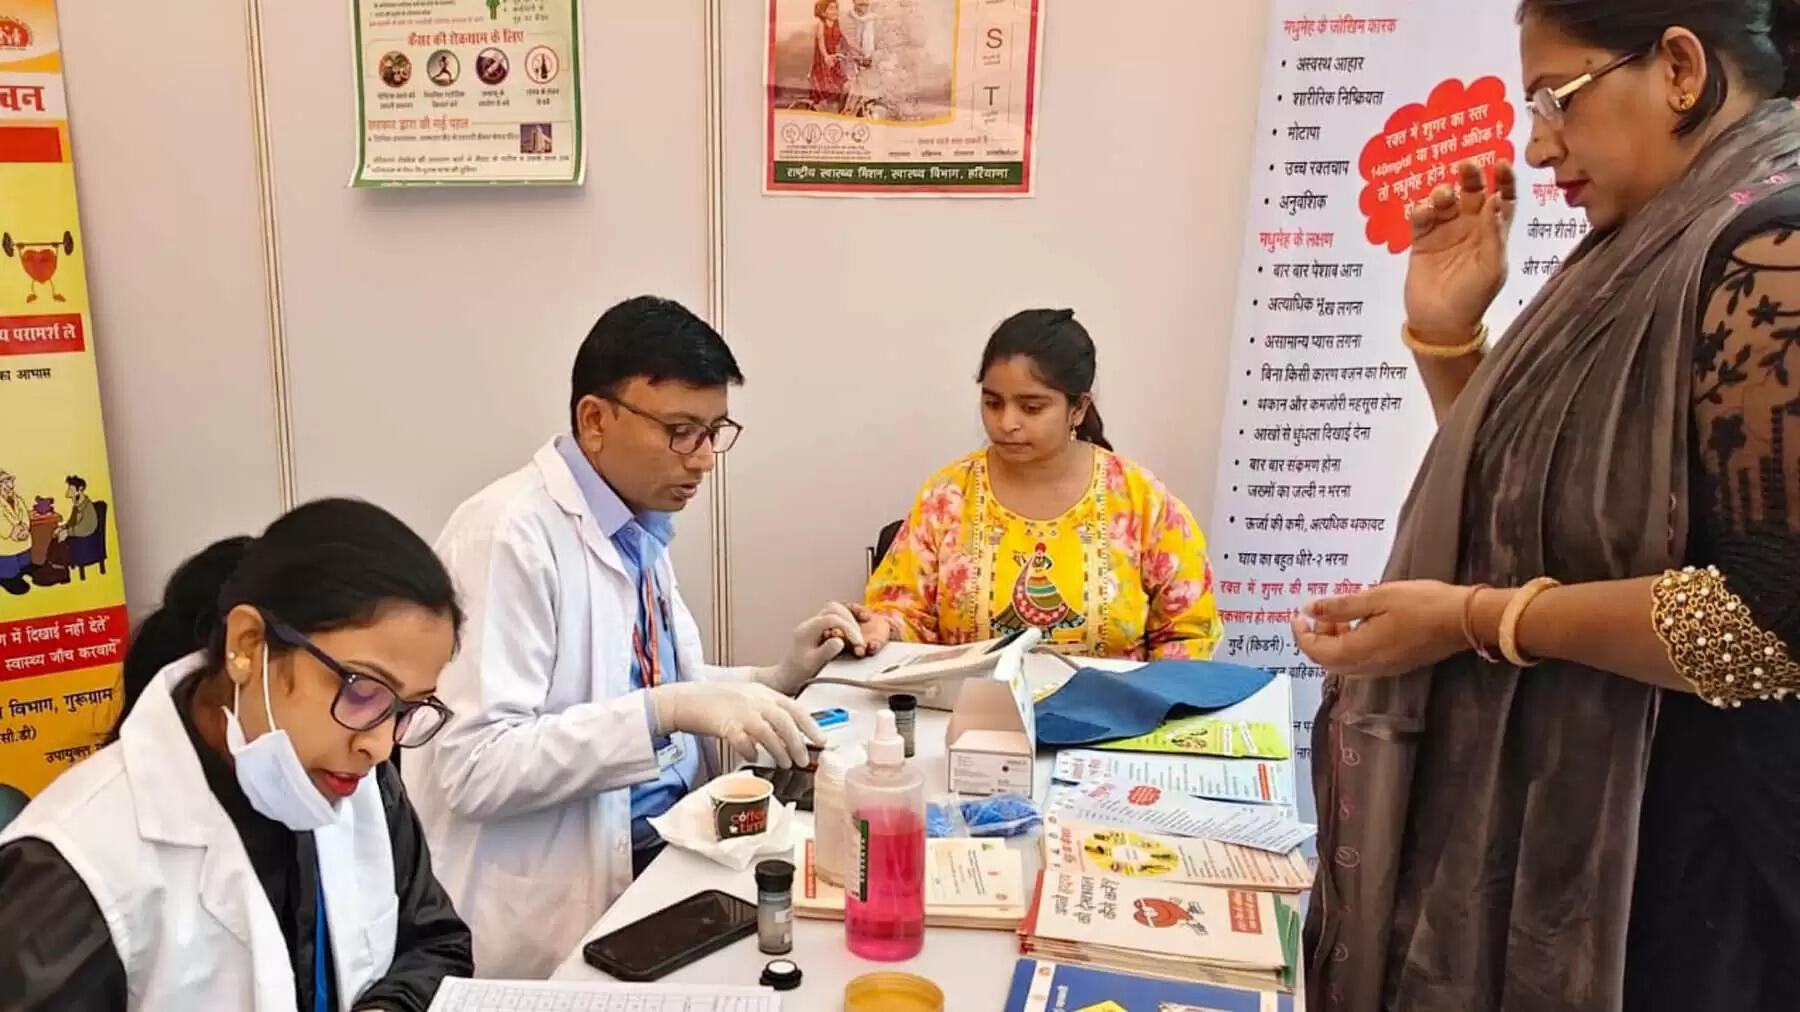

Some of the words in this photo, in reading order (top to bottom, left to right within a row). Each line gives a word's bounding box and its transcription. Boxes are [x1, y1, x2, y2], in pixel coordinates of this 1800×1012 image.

[1284, 15, 1315, 41] मधुमेह
[1318, 15, 1328, 33] के
[1330, 14, 1365, 33] जोखिम
[1368, 18, 1398, 32] कारक
[986, 28, 1003, 48] S
[1296, 57, 1332, 72] अस्वस्थ
[1334, 57, 1364, 72] आहार
[984, 86, 1000, 106] T
[1293, 86, 1335, 106] शारीरिक
[1288, 121, 1320, 140] मोटापा
[1386, 130, 1406, 148] रक्त
[1411, 122, 1419, 140] में
[1422, 117, 1446, 140] शुगर
[1451, 112, 1464, 128] का
[1469, 104, 1488, 120] स्तर
[1416, 148, 1428, 162] या
[1432, 134, 1456, 160] इससे
[1462, 128, 1492, 148] अधिक
[1285, 161, 1306, 176] उच्च
[1310, 160, 1350, 176] रक्तचाप
[1378, 183, 1388, 202] तो
[1394, 172, 1423, 200] मधुमेह
[1427, 162, 1446, 186] होने
[1472, 151, 1496, 168] तरा
[1528, 217, 1552, 239] जीवन
[1555, 217, 1576, 239] शैली
[1260, 228, 1290, 253] मधुमेह
[1293, 228, 1304, 248] के
[1306, 233, 1334, 248] लक्षण
[1273, 264, 1289, 278] बार
[1292, 264, 1309, 278] बार
[1312, 260, 1338, 278] पेशाब
[1340, 264, 1363, 278] आना
[1522, 256, 1540, 275] और
[1268, 293, 1313, 312] अत्याधिक
[1337, 301, 1363, 316] लगना
[1264, 335, 1309, 349] असामान्य
[1312, 335, 1334, 349] प्यास
[1336, 334, 1362, 349] लगना
[16, 368, 51, 380] आभास
[1262, 363, 1282, 382] बिना
[1285, 363, 1310, 382] किसी
[1312, 368, 1338, 382] कारण
[1366, 367, 1377, 379] का
[1380, 362, 1408, 379] गिरना
[1258, 398, 1286, 411] थकान
[1290, 395, 1308, 411] और
[1310, 393, 1346, 411] कमजोरी
[1349, 398, 1378, 414] महसूस
[1381, 393, 1402, 411] होना
[1282, 423, 1291, 440] से
[1322, 422, 1350, 442] दिखाई
[1354, 422, 1371, 440] देना
[1250, 458, 1266, 472] बार
[1269, 458, 1284, 472] बार
[1322, 454, 1342, 472] होना
[1278, 485, 1290, 498] का
[1292, 481, 1316, 498] जल्दी
[1318, 485, 1326, 498] न
[1328, 485, 1352, 498] भरना
[1245, 513, 1269, 531] ऊर्जा
[1271, 513, 1283, 531] की
[1350, 518, 1384, 532] थकावट
[1238, 552, 1256, 566] घाव
[1259, 552, 1272, 566] का
[1274, 553, 1293, 572] बहुत
[1325, 552, 1348, 566] भरना
[1220, 581, 1242, 595] रक्त
[1248, 578, 1256, 595] में
[1262, 583, 1284, 600] शुगर
[1290, 578, 1301, 595] की
[1308, 583, 1330, 596] मात्रा
[1332, 578, 1362, 595] अधिक
[1254, 606, 1264, 625] हो
[1266, 608, 1291, 624] सकते
[11, 627, 22, 644] में
[26, 621, 60, 643] दिखाई
[4, 654, 45, 671] स्वास्थ्य
[1288, 662, 1326, 680] वाहिका
